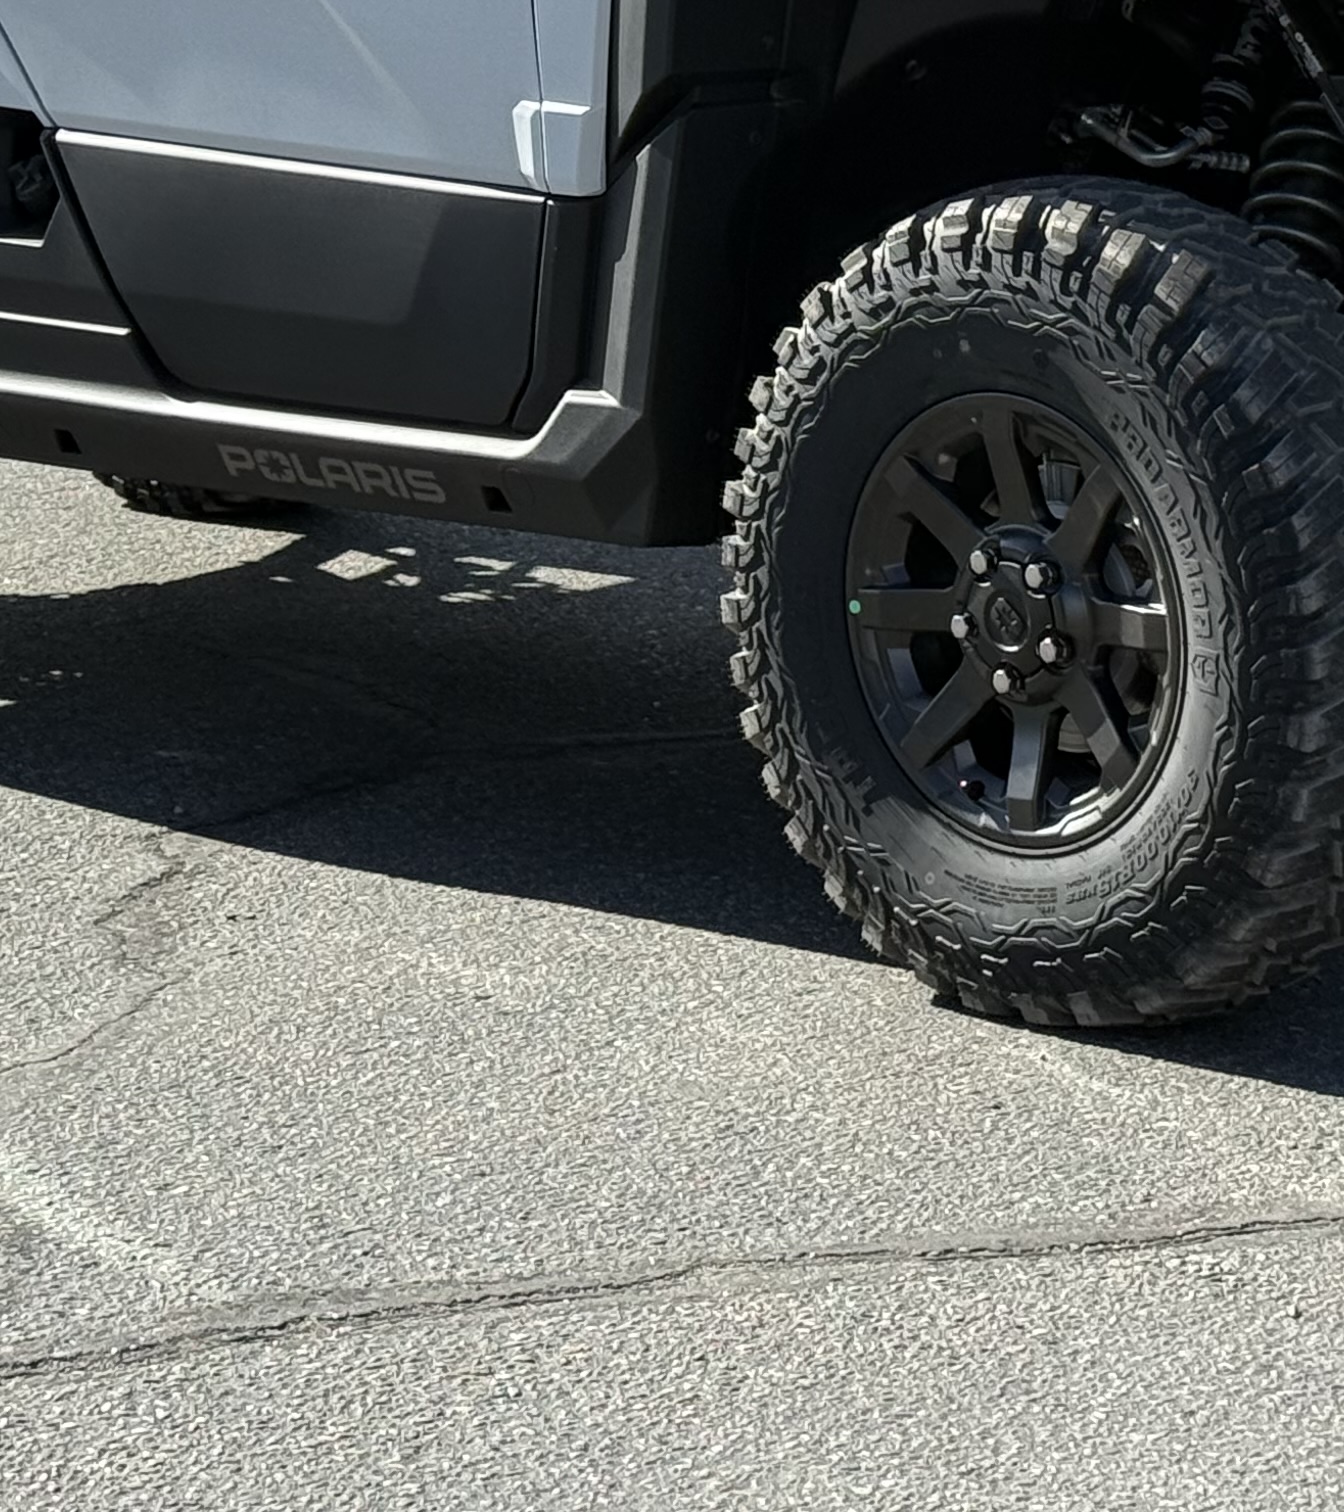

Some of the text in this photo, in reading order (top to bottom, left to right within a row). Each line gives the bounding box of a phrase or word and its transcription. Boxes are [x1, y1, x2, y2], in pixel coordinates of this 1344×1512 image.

[216, 442, 447, 505] POLARIS
[1105, 409, 1213, 639] PRO ARMOR
